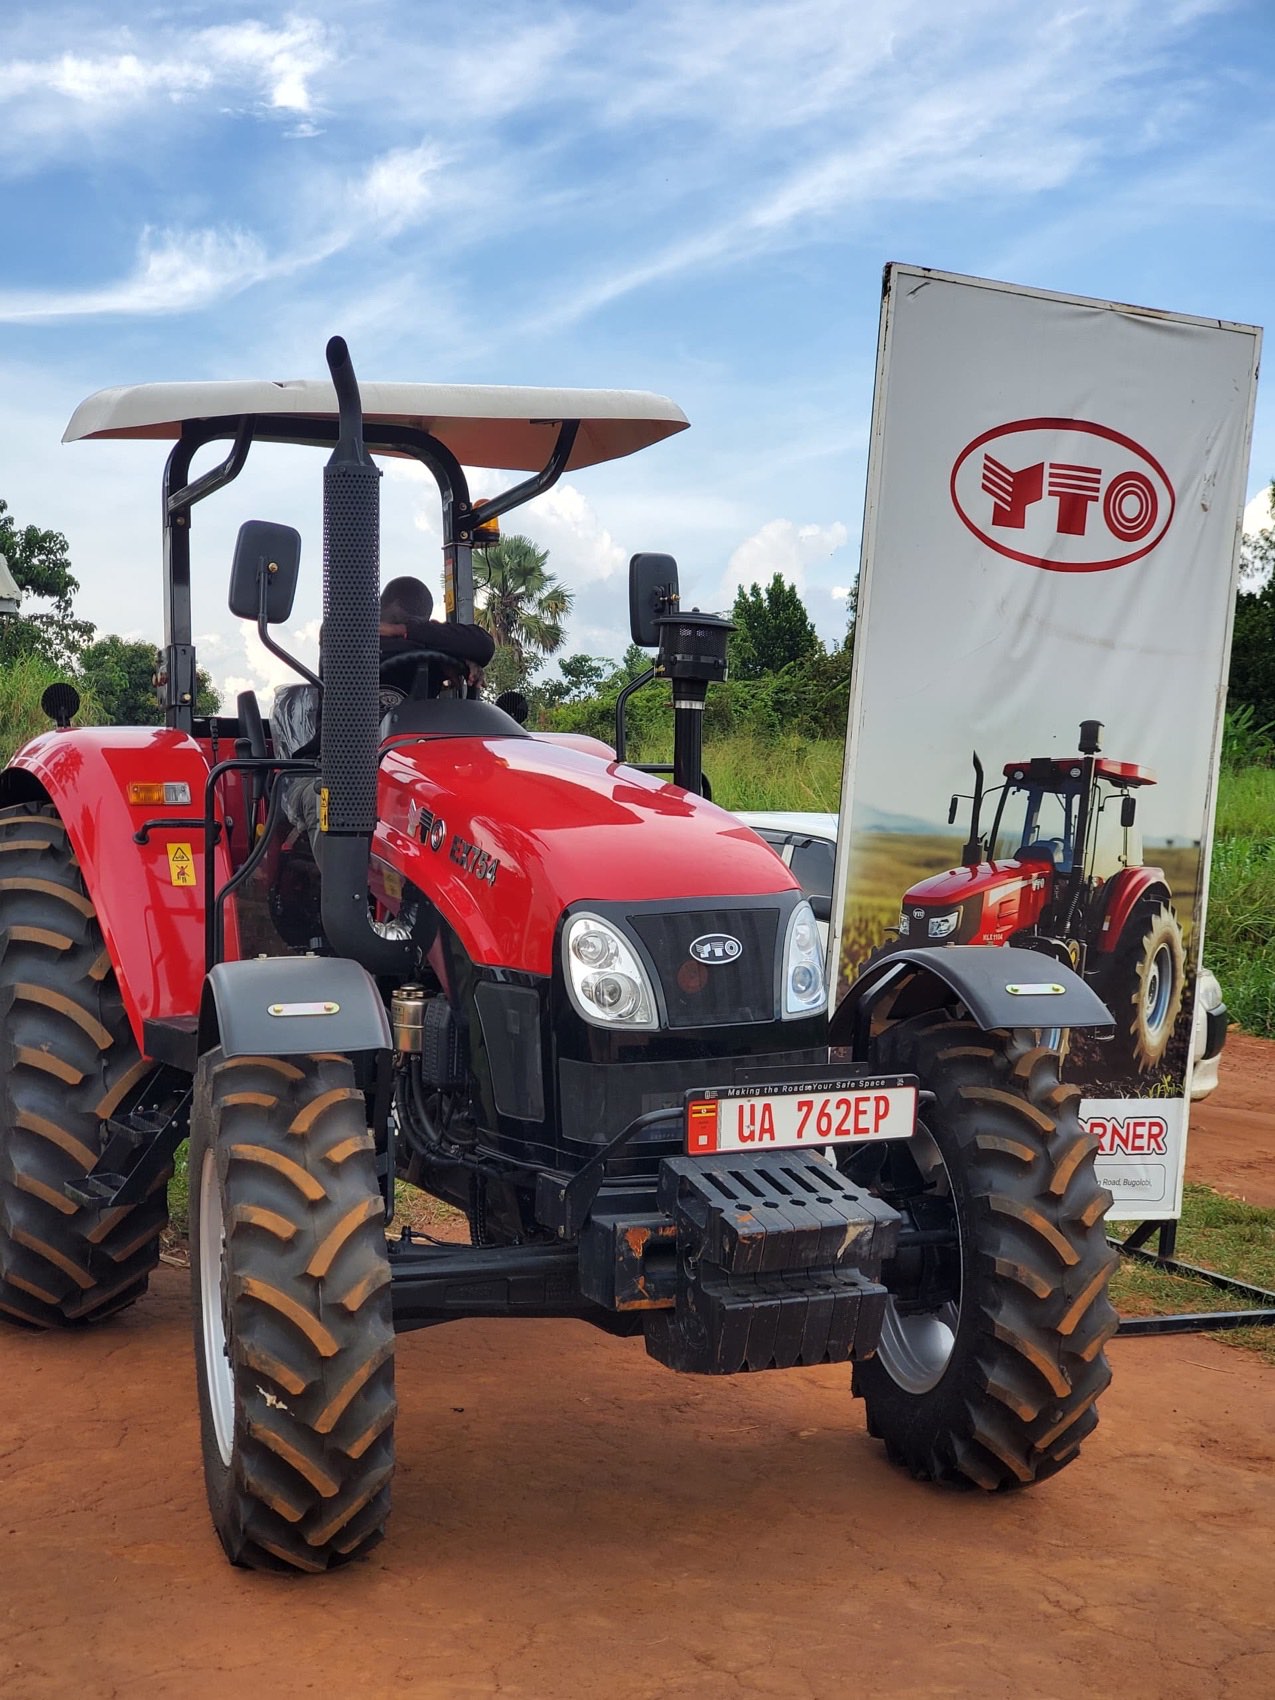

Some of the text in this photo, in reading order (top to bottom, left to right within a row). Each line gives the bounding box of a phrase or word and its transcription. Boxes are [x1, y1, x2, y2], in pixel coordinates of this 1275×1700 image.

[981, 452, 1158, 542] YTO
[407, 798, 446, 852] YTO
[449, 835, 500, 887] EX754
[695, 941, 739, 958] YTO
[727, 1087, 760, 1096] Making
[764, 1086, 779, 1094] the
[836, 1081, 856, 1089] Safe
[859, 1079, 886, 1089] Space
[738, 1096, 890, 1143] UA 762EP
[1080, 1121, 1164, 1152] RNER
